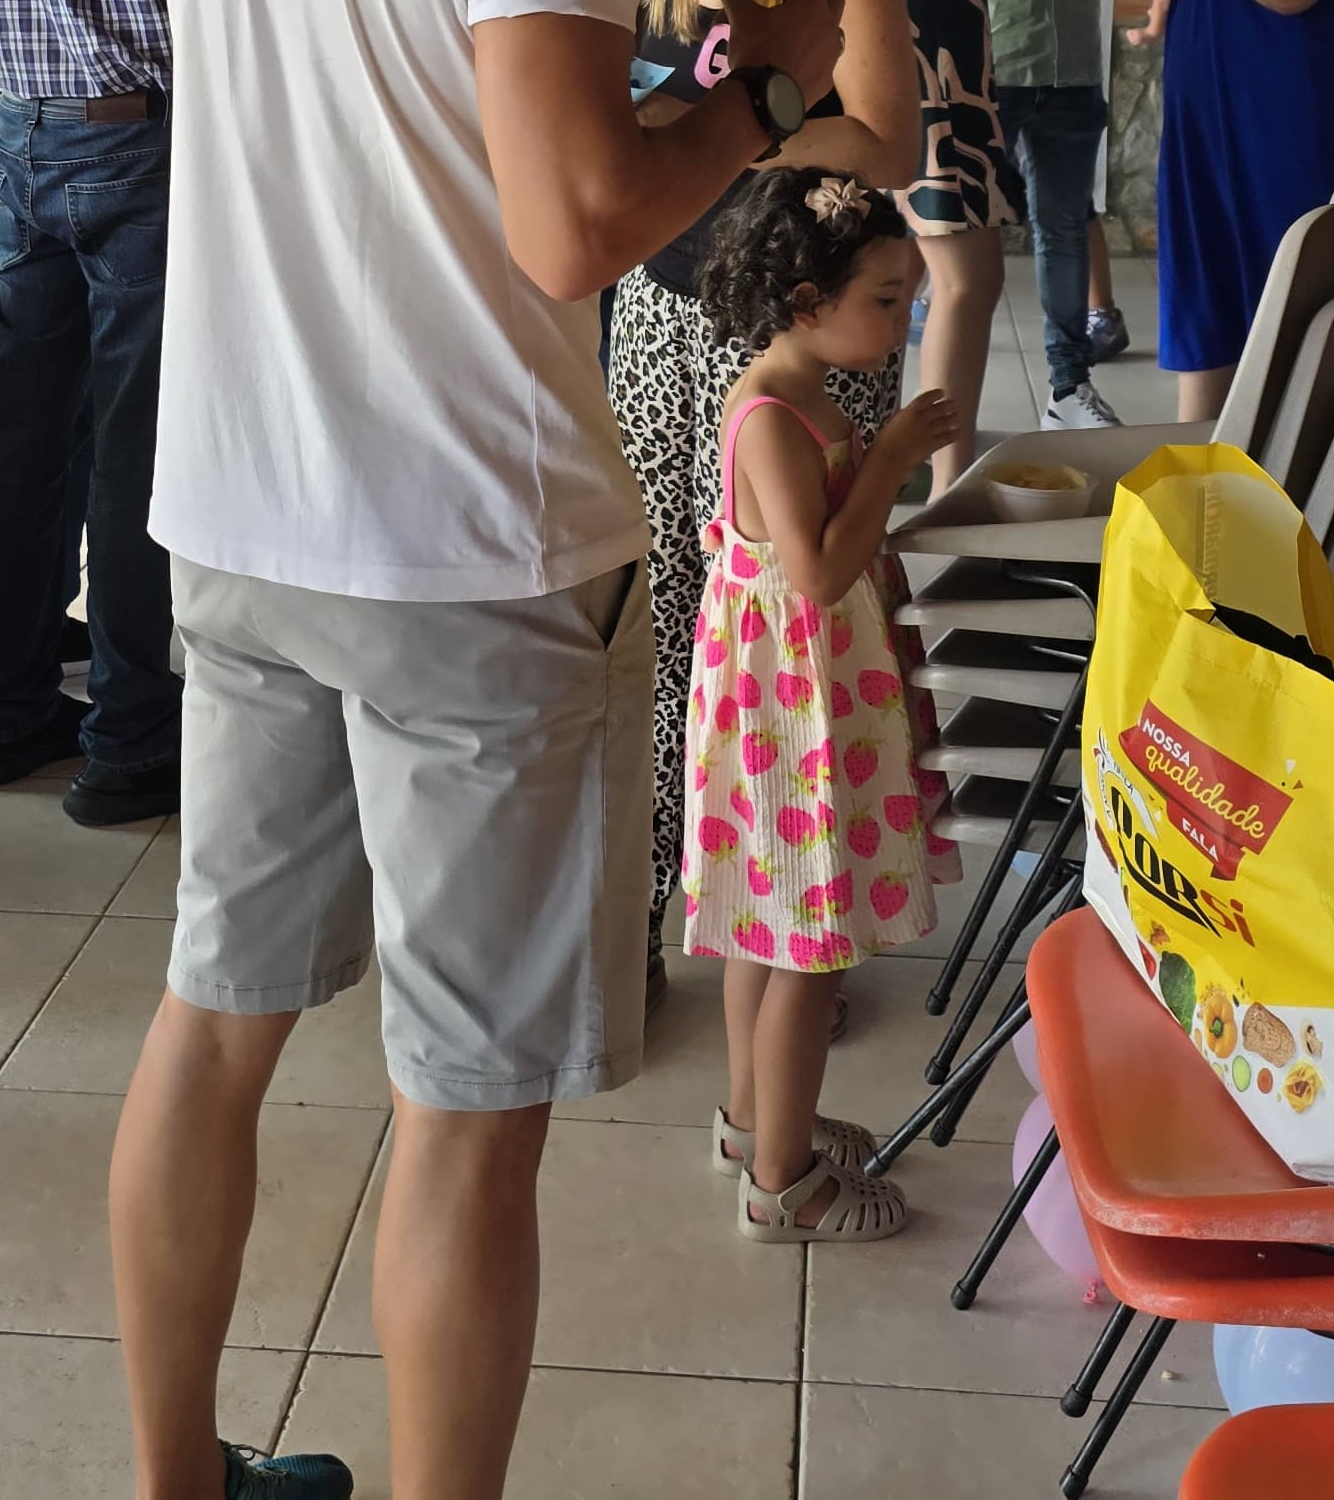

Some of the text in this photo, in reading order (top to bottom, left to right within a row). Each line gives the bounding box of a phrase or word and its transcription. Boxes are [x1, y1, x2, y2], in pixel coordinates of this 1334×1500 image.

[694, 23, 731, 89] G
[1142, 718, 1191, 768] NOSSA
[1145, 745, 1265, 838] qualidade
[1181, 817, 1219, 861] FALA
